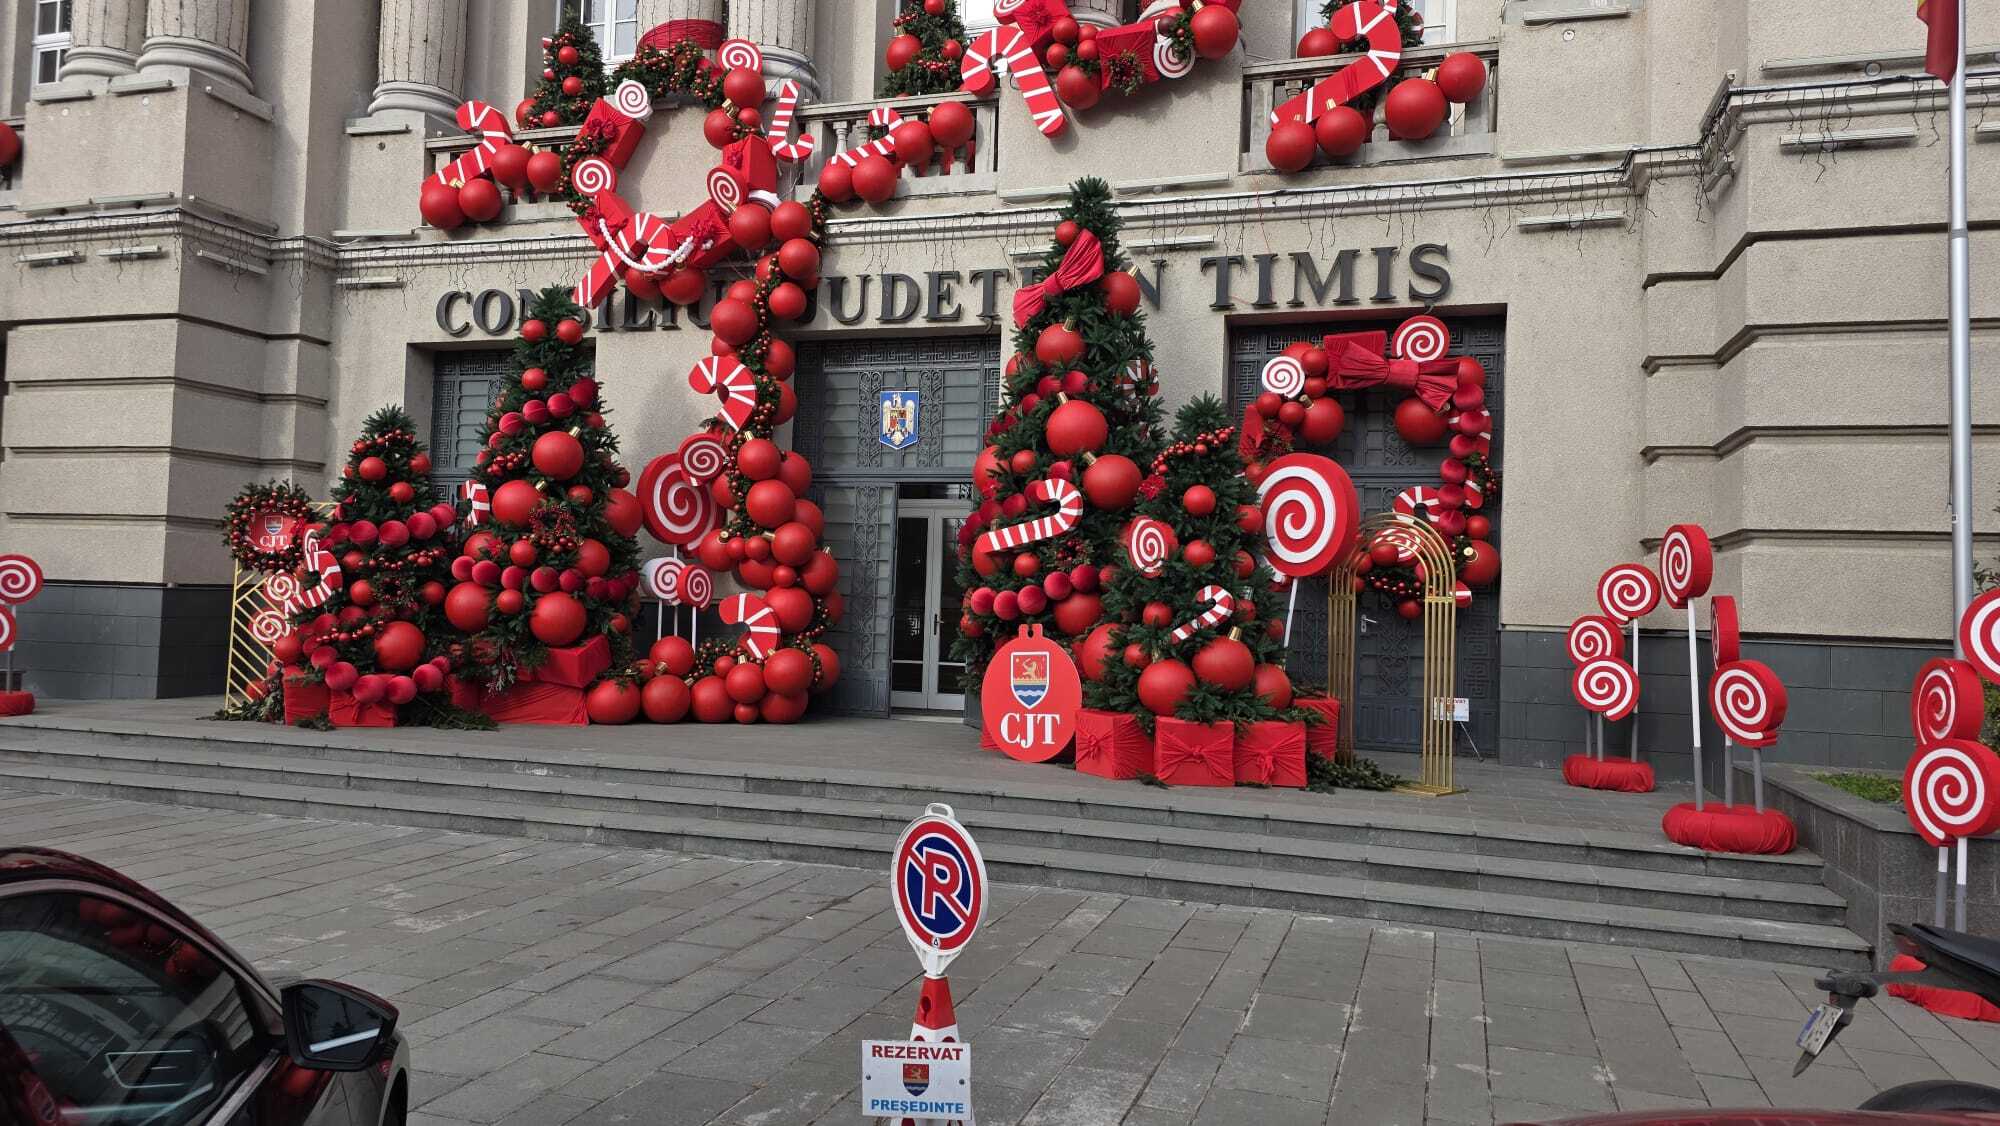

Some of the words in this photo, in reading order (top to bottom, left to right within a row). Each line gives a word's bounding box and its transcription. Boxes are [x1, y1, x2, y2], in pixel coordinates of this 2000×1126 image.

[260, 535, 288, 548] CJT
[1000, 712, 1060, 749] CJT
[871, 1045, 964, 1060] REZERVAT
